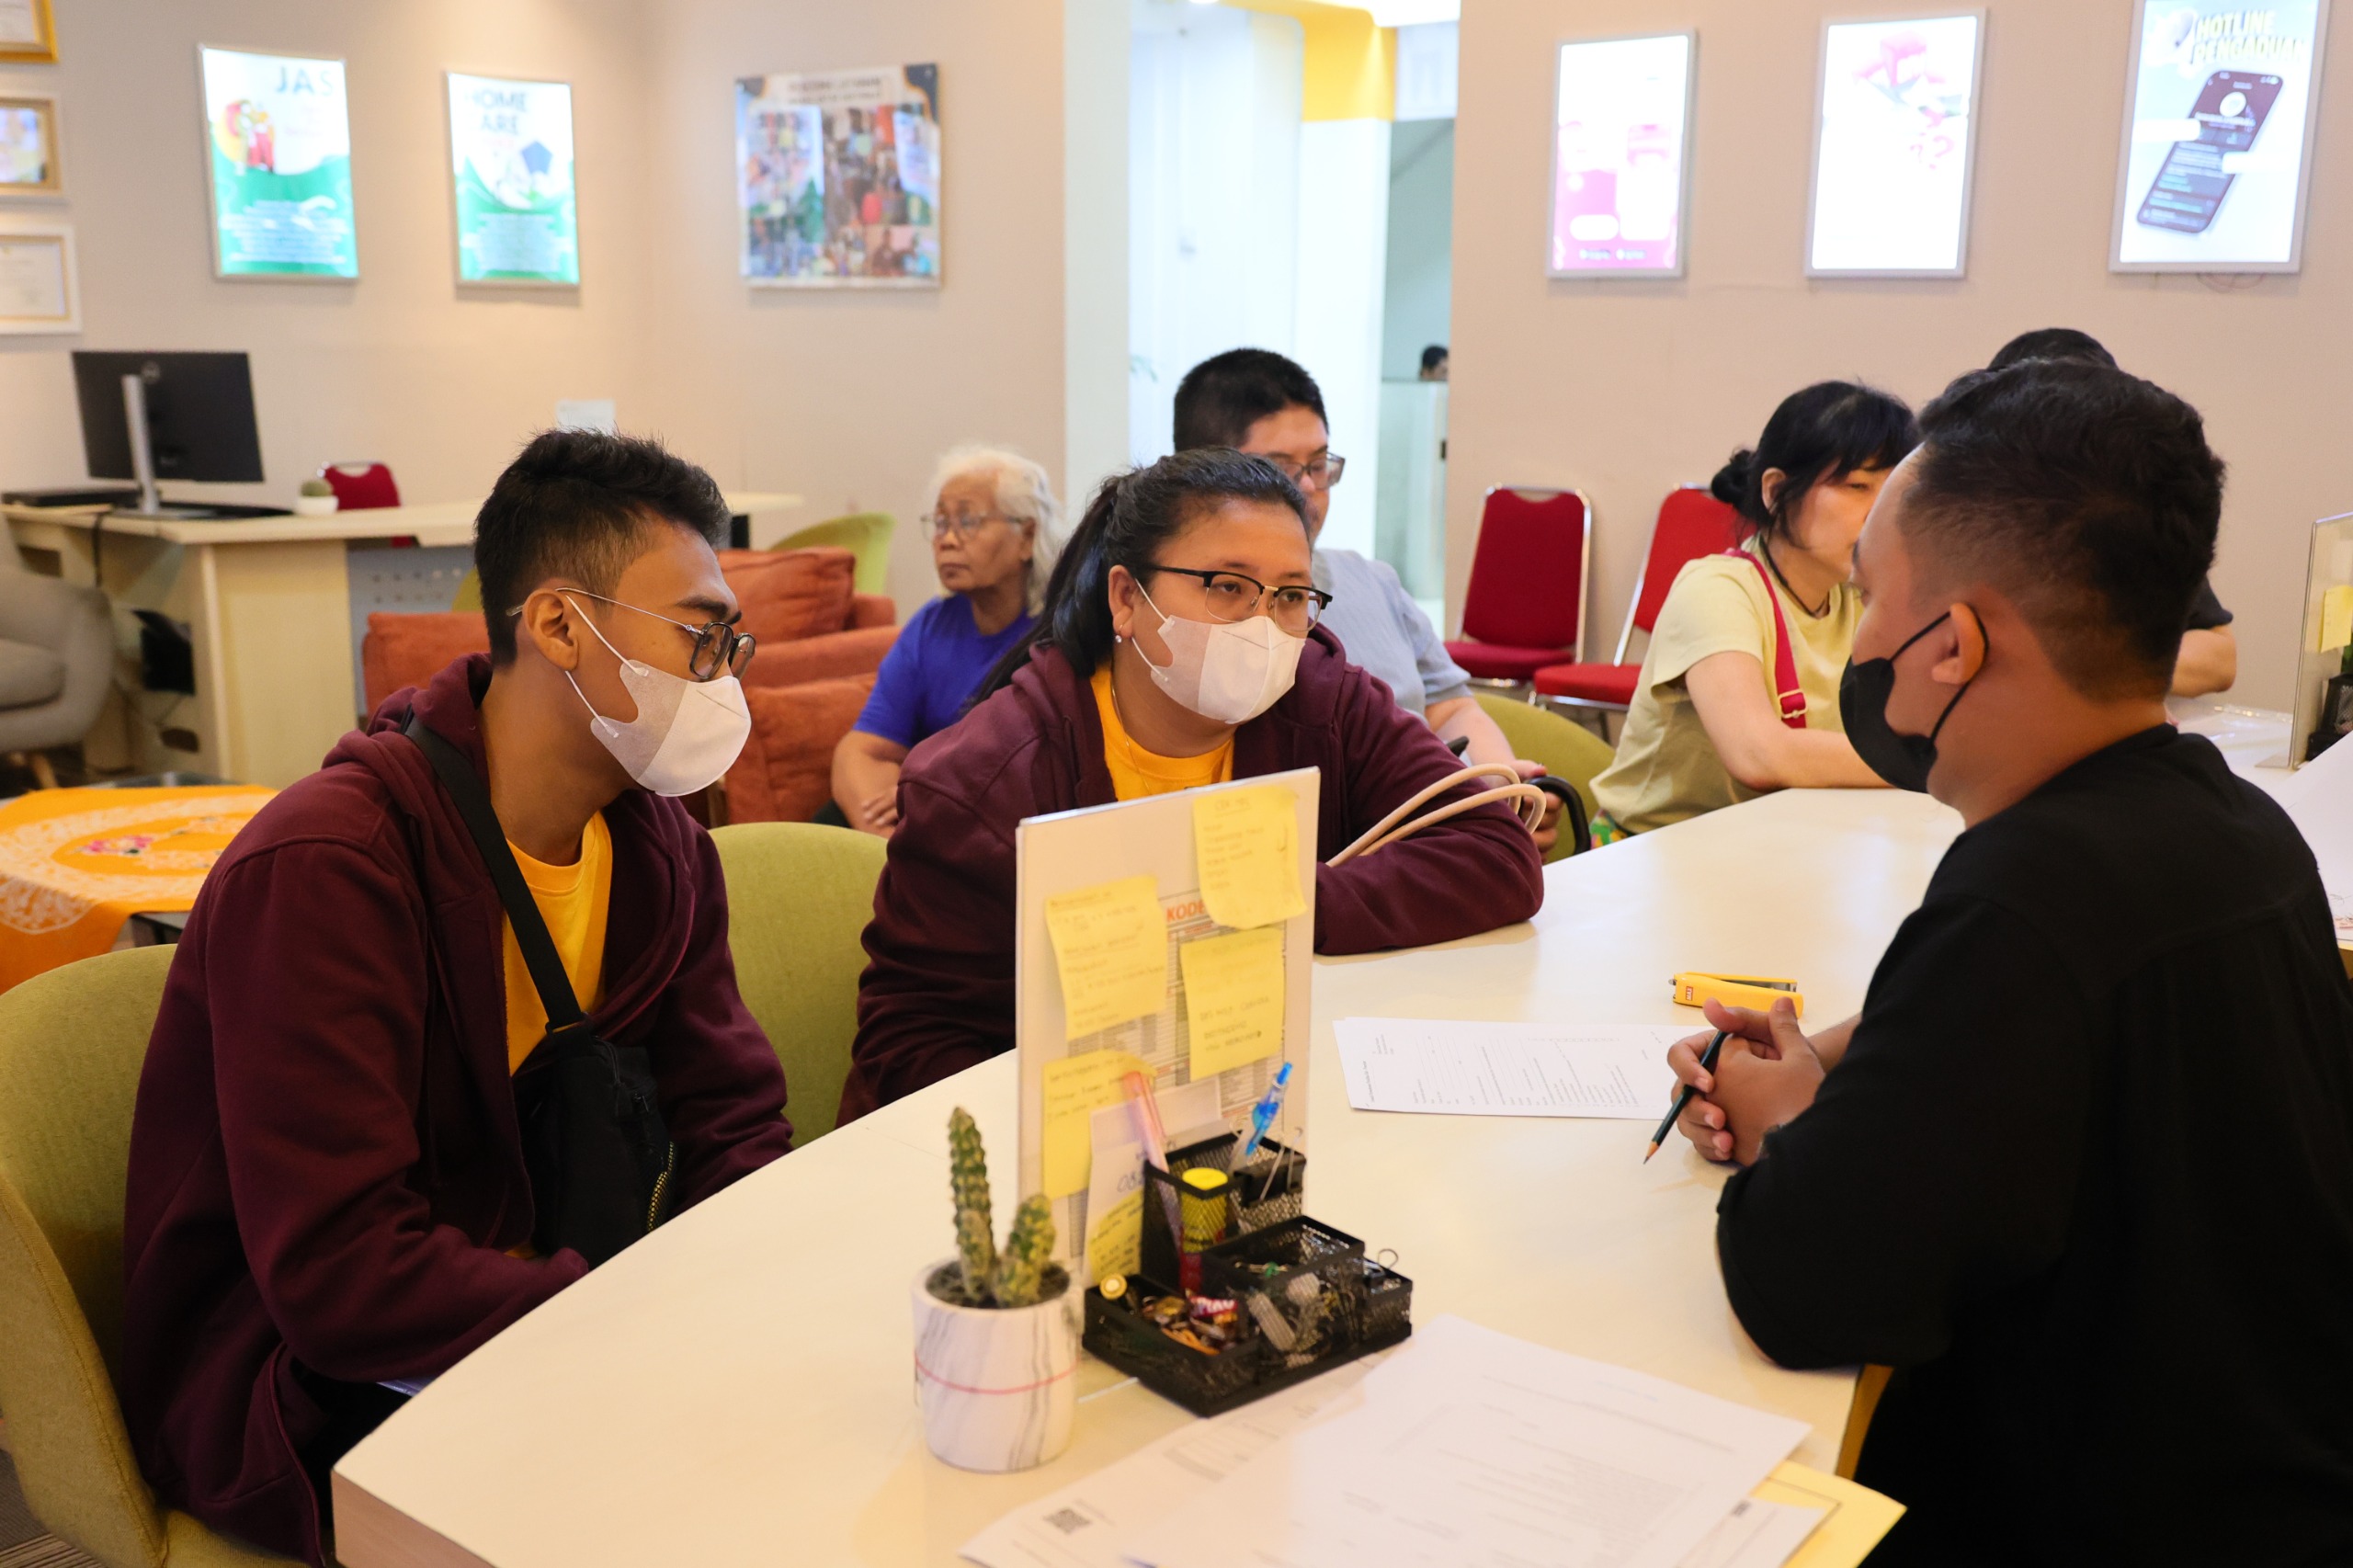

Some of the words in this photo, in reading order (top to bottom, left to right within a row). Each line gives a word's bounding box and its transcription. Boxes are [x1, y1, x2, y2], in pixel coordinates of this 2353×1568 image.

[2196, 9, 2276, 42] HOTLINE
[276, 65, 334, 97] JAS
[476, 114, 519, 136] ARE
